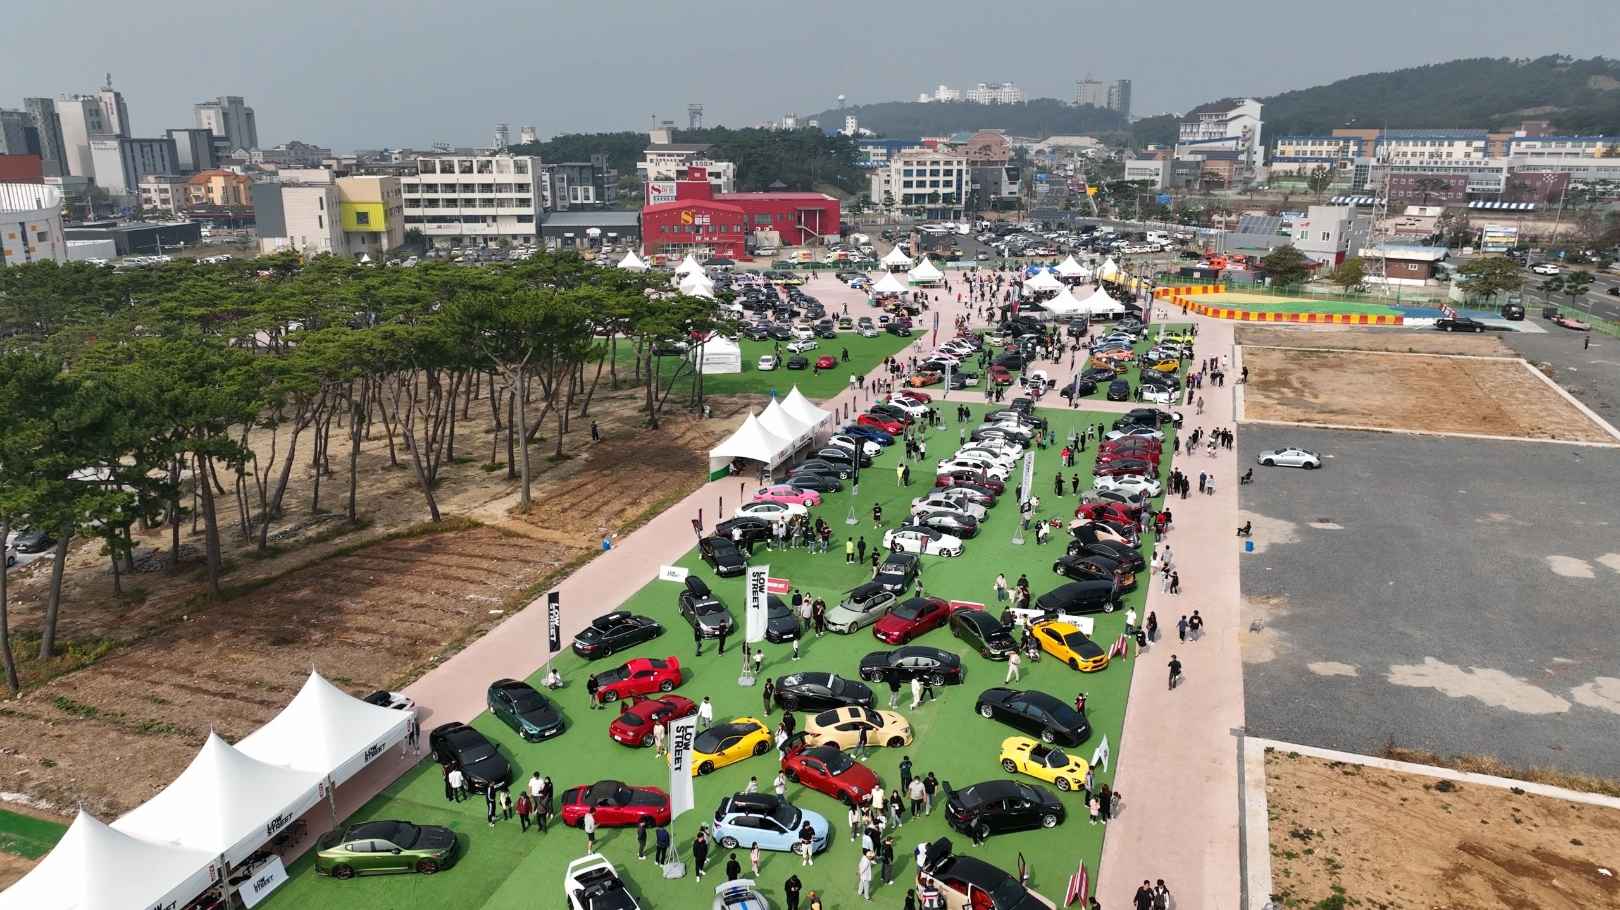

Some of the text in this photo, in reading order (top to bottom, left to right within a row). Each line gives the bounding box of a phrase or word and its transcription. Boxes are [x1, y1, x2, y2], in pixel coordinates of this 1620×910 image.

[752, 571, 760, 610] STREET
[758, 571, 767, 594] LOW
[552, 602, 560, 627] LOW
[674, 726, 685, 771] STREET
[682, 725, 694, 751] LOW
